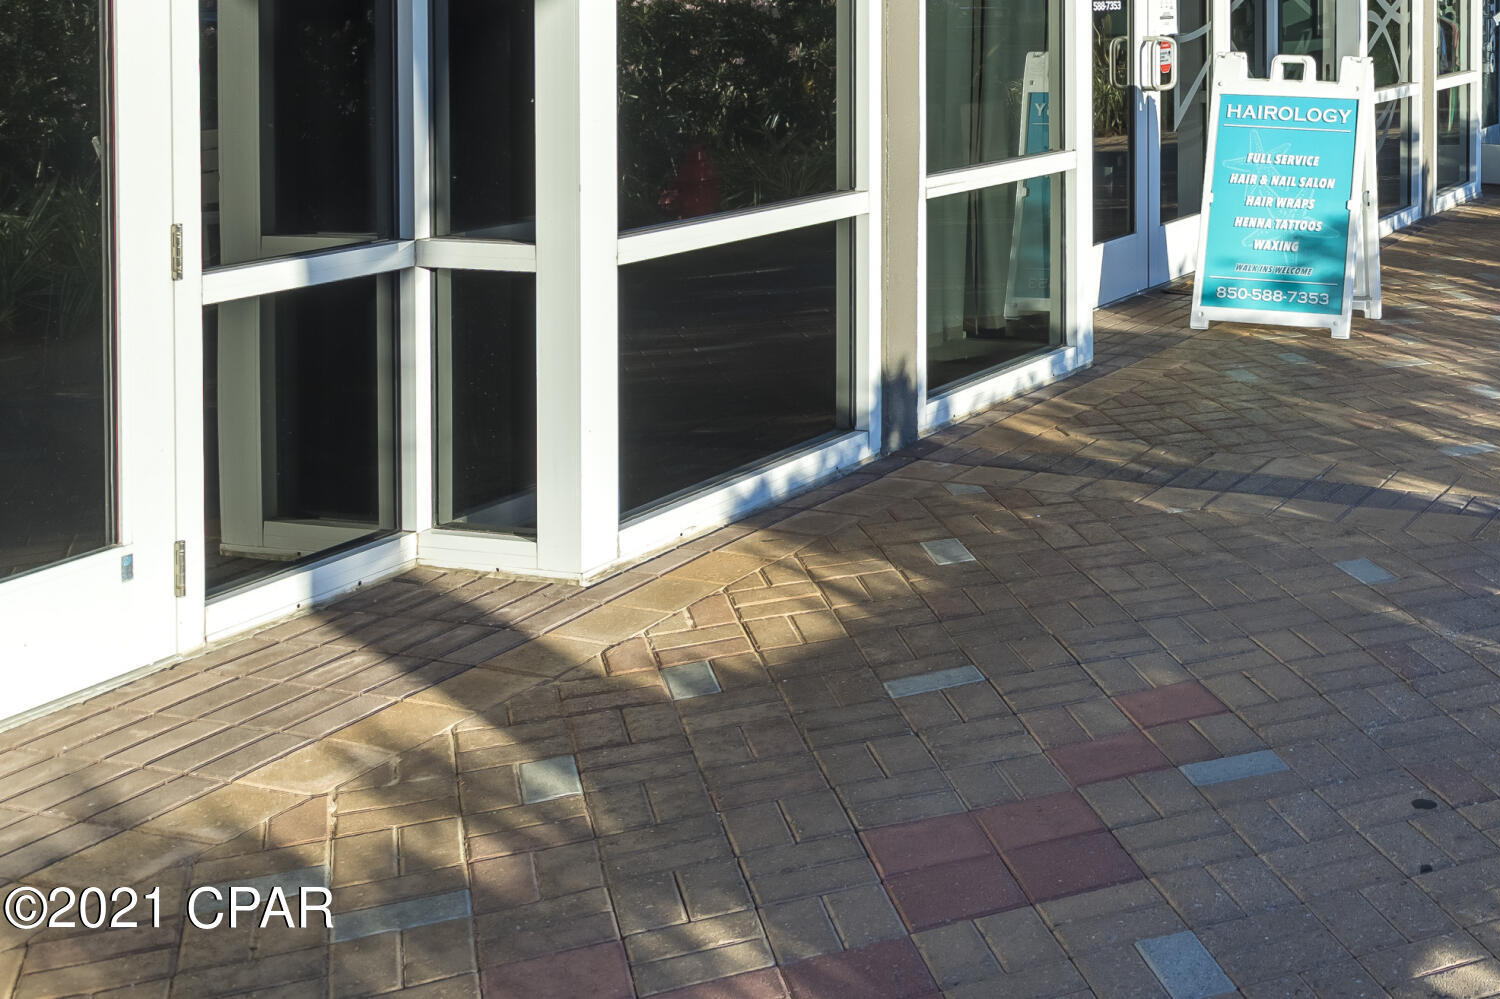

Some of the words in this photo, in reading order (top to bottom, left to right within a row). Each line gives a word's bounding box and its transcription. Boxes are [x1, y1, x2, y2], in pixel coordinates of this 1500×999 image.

[1226, 104, 1352, 124] HAIROLOGY
[1246, 152, 1272, 165] FULL
[1274, 154, 1320, 167] SERVICE
[1229, 173, 1257, 185] HAIR
[1259, 175, 1268, 185] &
[1270, 175, 1296, 187] NAIL
[1299, 177, 1336, 189] SALON
[1245, 195, 1274, 208] HAIR
[1276, 197, 1316, 210] WRAPS
[1233, 216, 1272, 229] HENNA
[1275, 219, 1323, 232] TATTOOS
[1253, 239, 1299, 252] WAXING
[1235, 263, 1257, 272] WALK
[1259, 264, 1273, 273] INS
[1274, 265, 1314, 276] WELCOME
[1216, 286, 1329, 305] 850-588-7353
